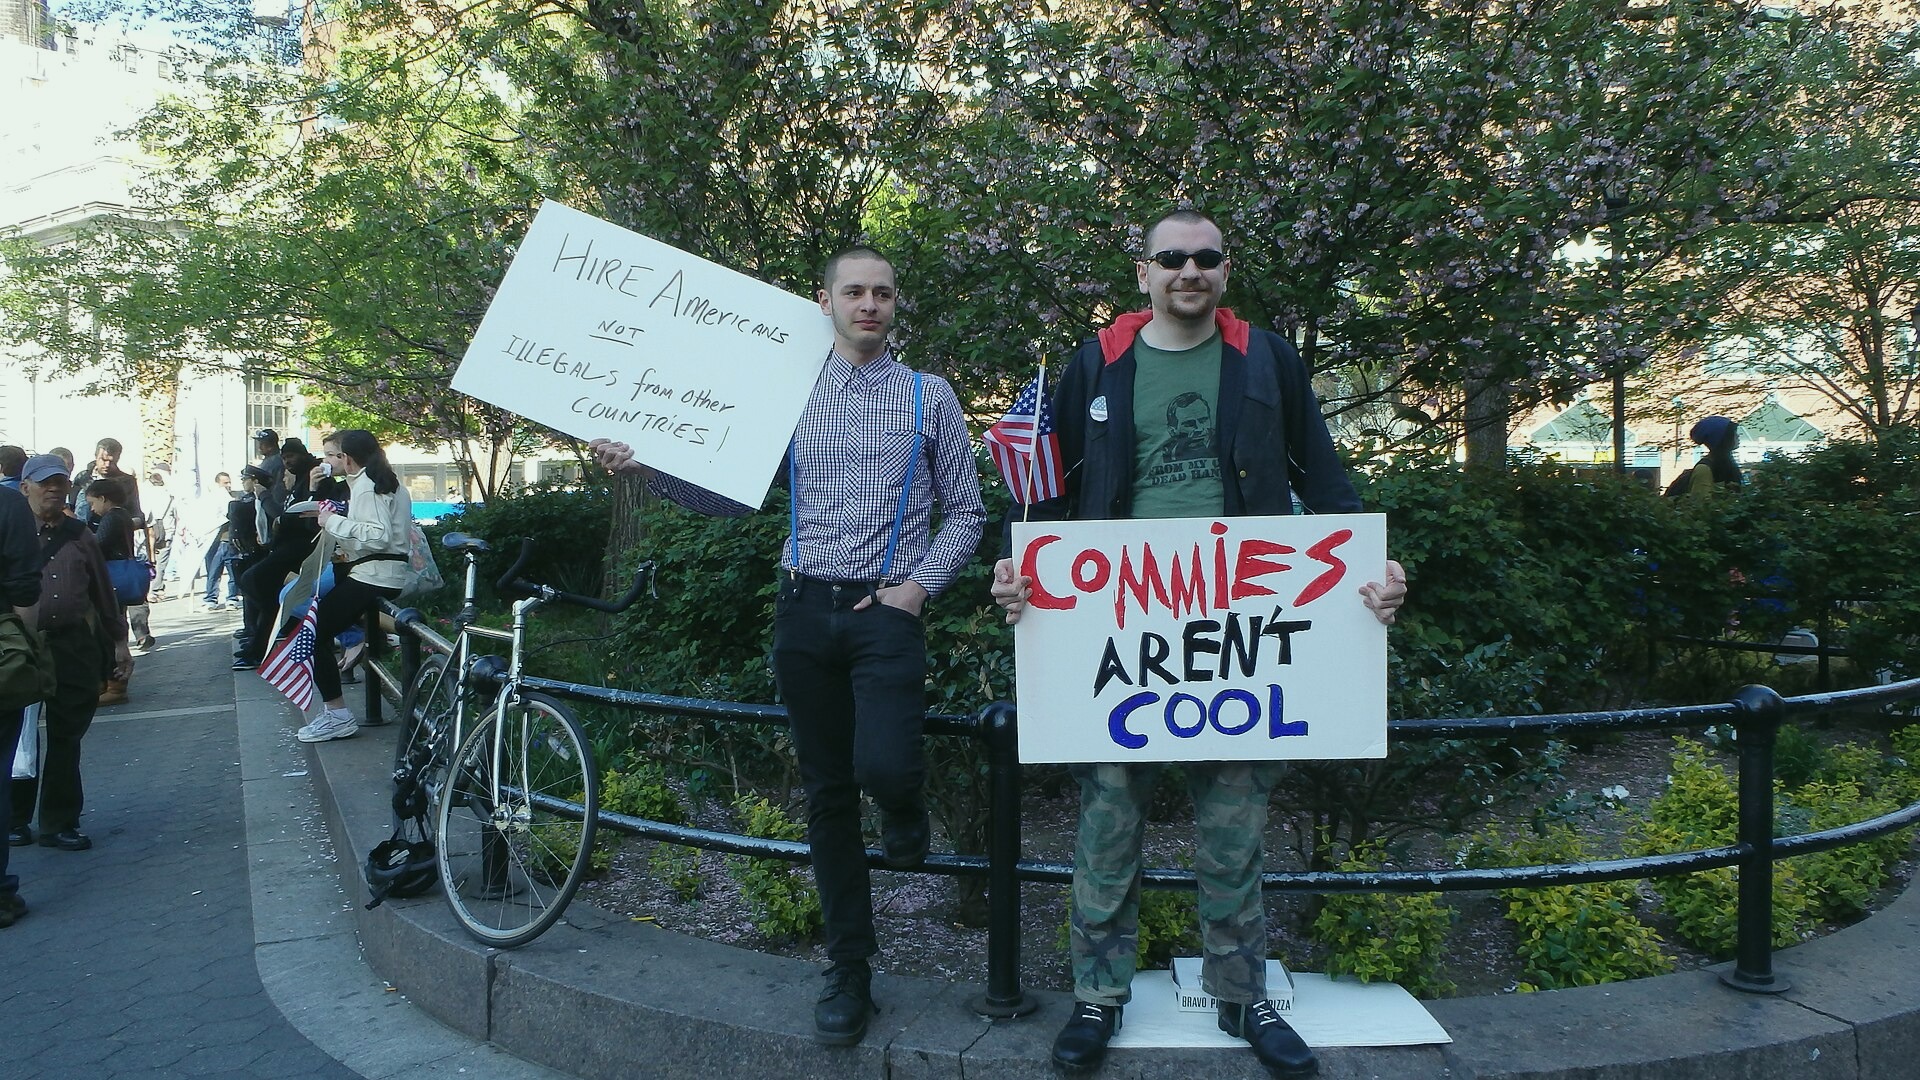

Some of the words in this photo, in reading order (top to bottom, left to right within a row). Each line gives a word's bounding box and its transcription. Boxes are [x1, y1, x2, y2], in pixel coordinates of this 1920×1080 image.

[552, 232, 655, 298] HIRE
[597, 319, 645, 338] NOT
[501, 334, 619, 387] ILLEGALS
[1151, 472, 1187, 486] DEAD
[1190, 468, 1221, 480] HAN
[1093, 604, 1312, 699] AREN'T
[1107, 683, 1309, 750] COOL
[1181, 995, 1207, 1008] BRAVO
